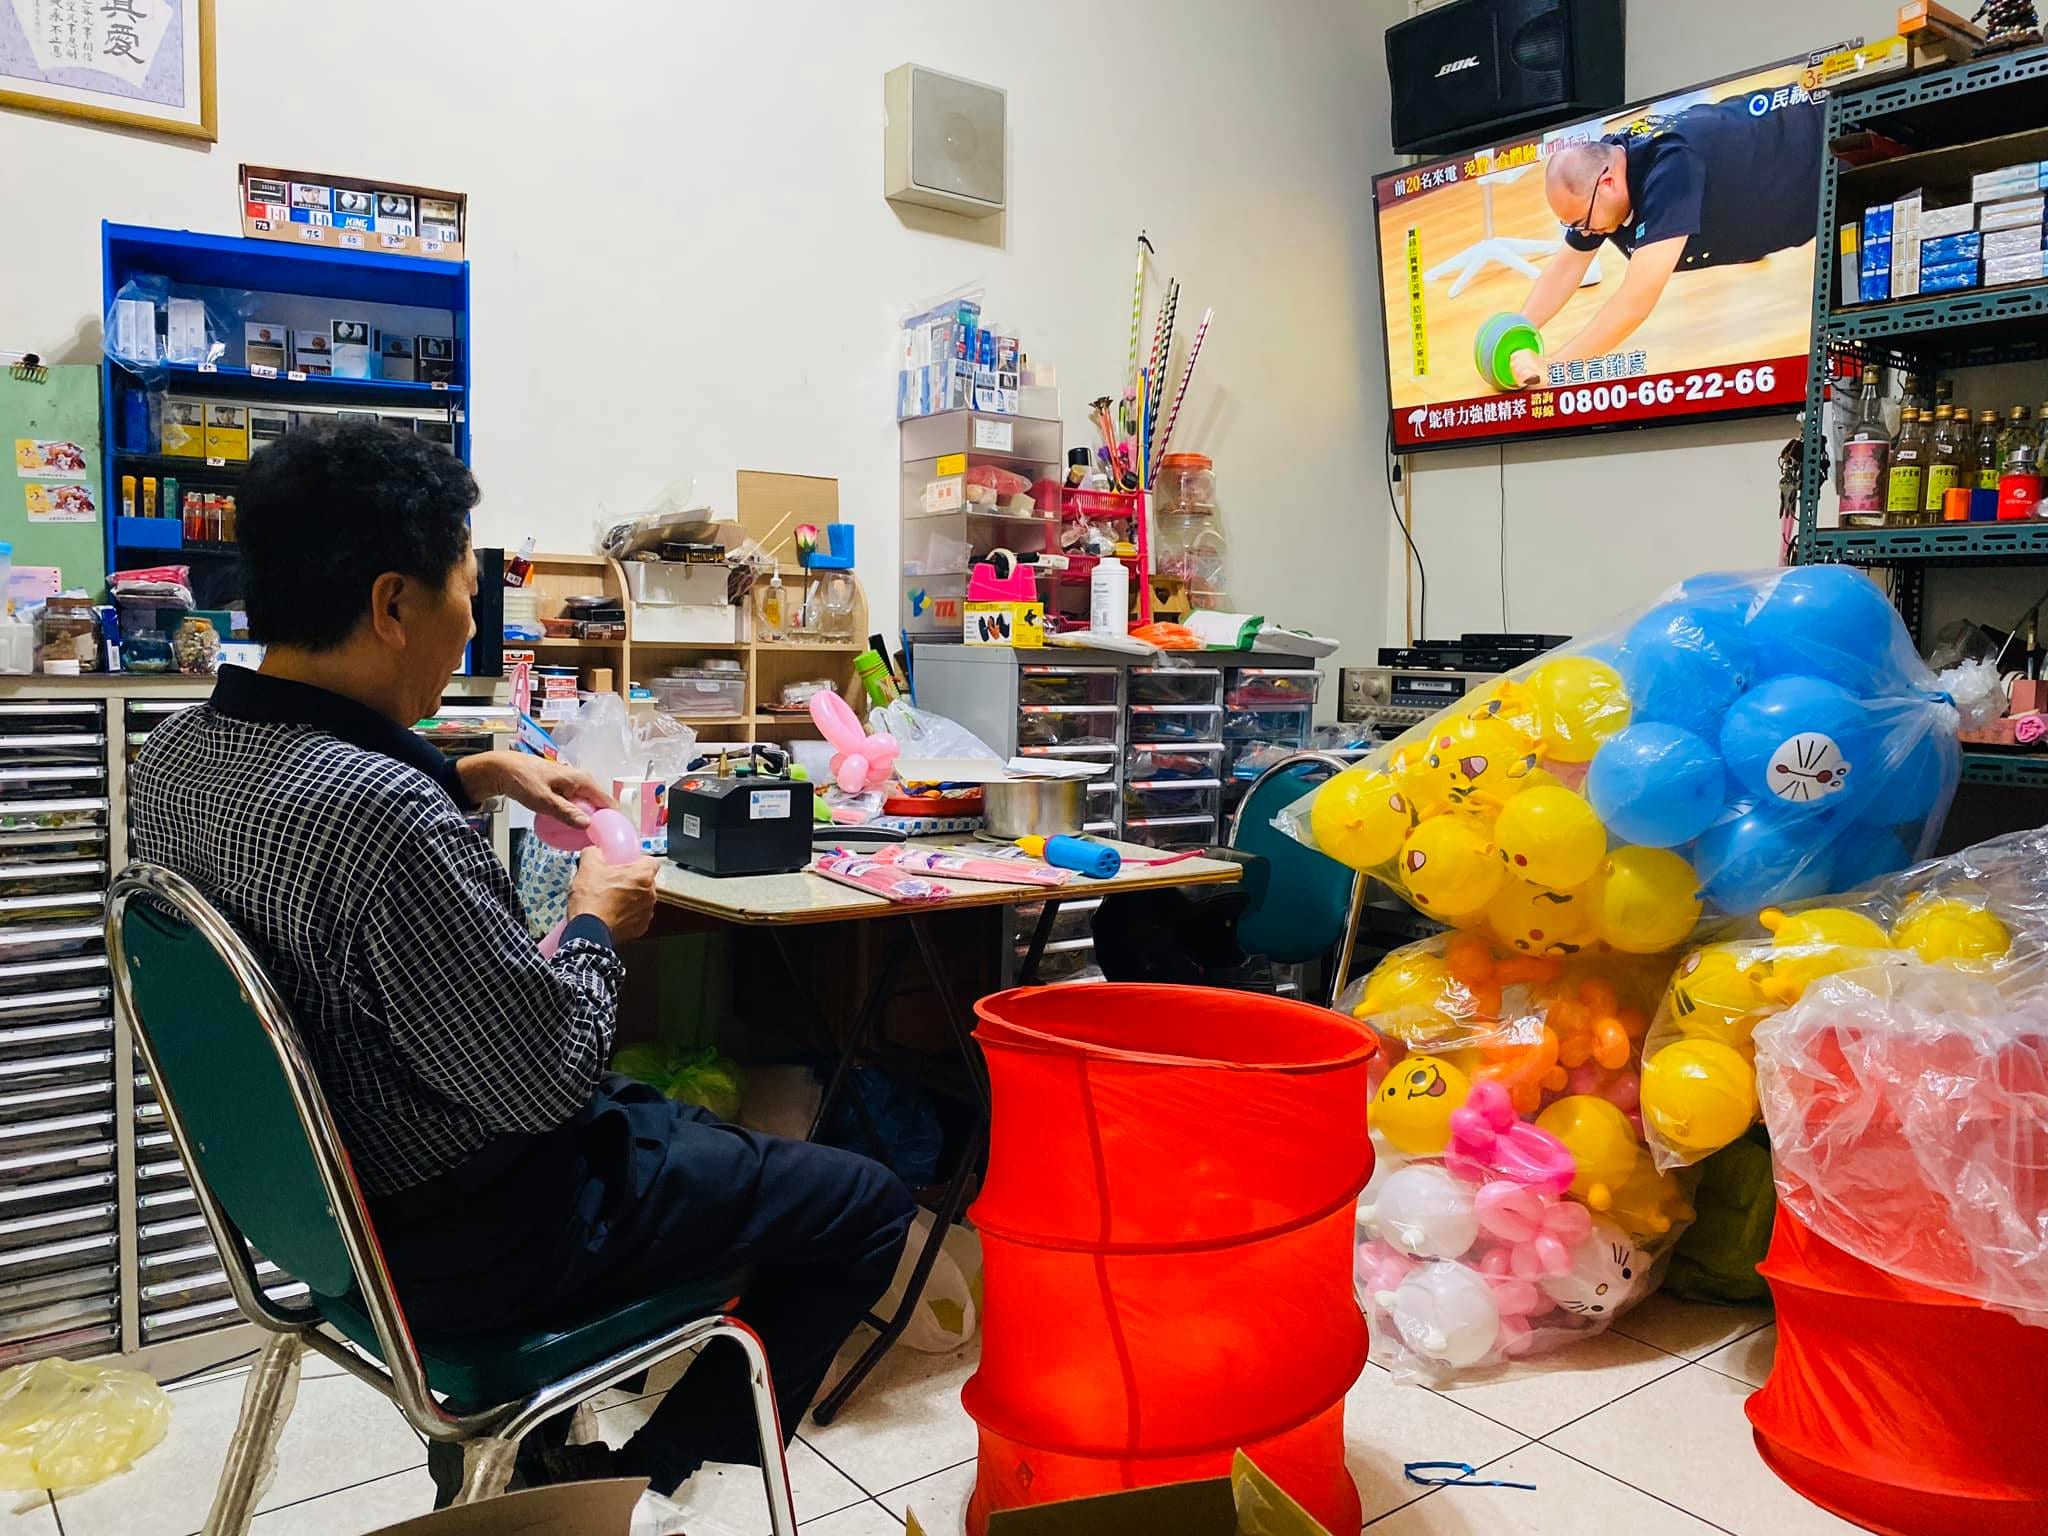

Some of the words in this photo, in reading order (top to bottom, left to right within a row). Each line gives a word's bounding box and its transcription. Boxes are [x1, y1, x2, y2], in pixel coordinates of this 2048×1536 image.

[1395, 166, 1458, 197] 前20名來電
[1547, 350, 1647, 386] 連這高難度
[1559, 366, 1776, 415] 0800-66-22-66
